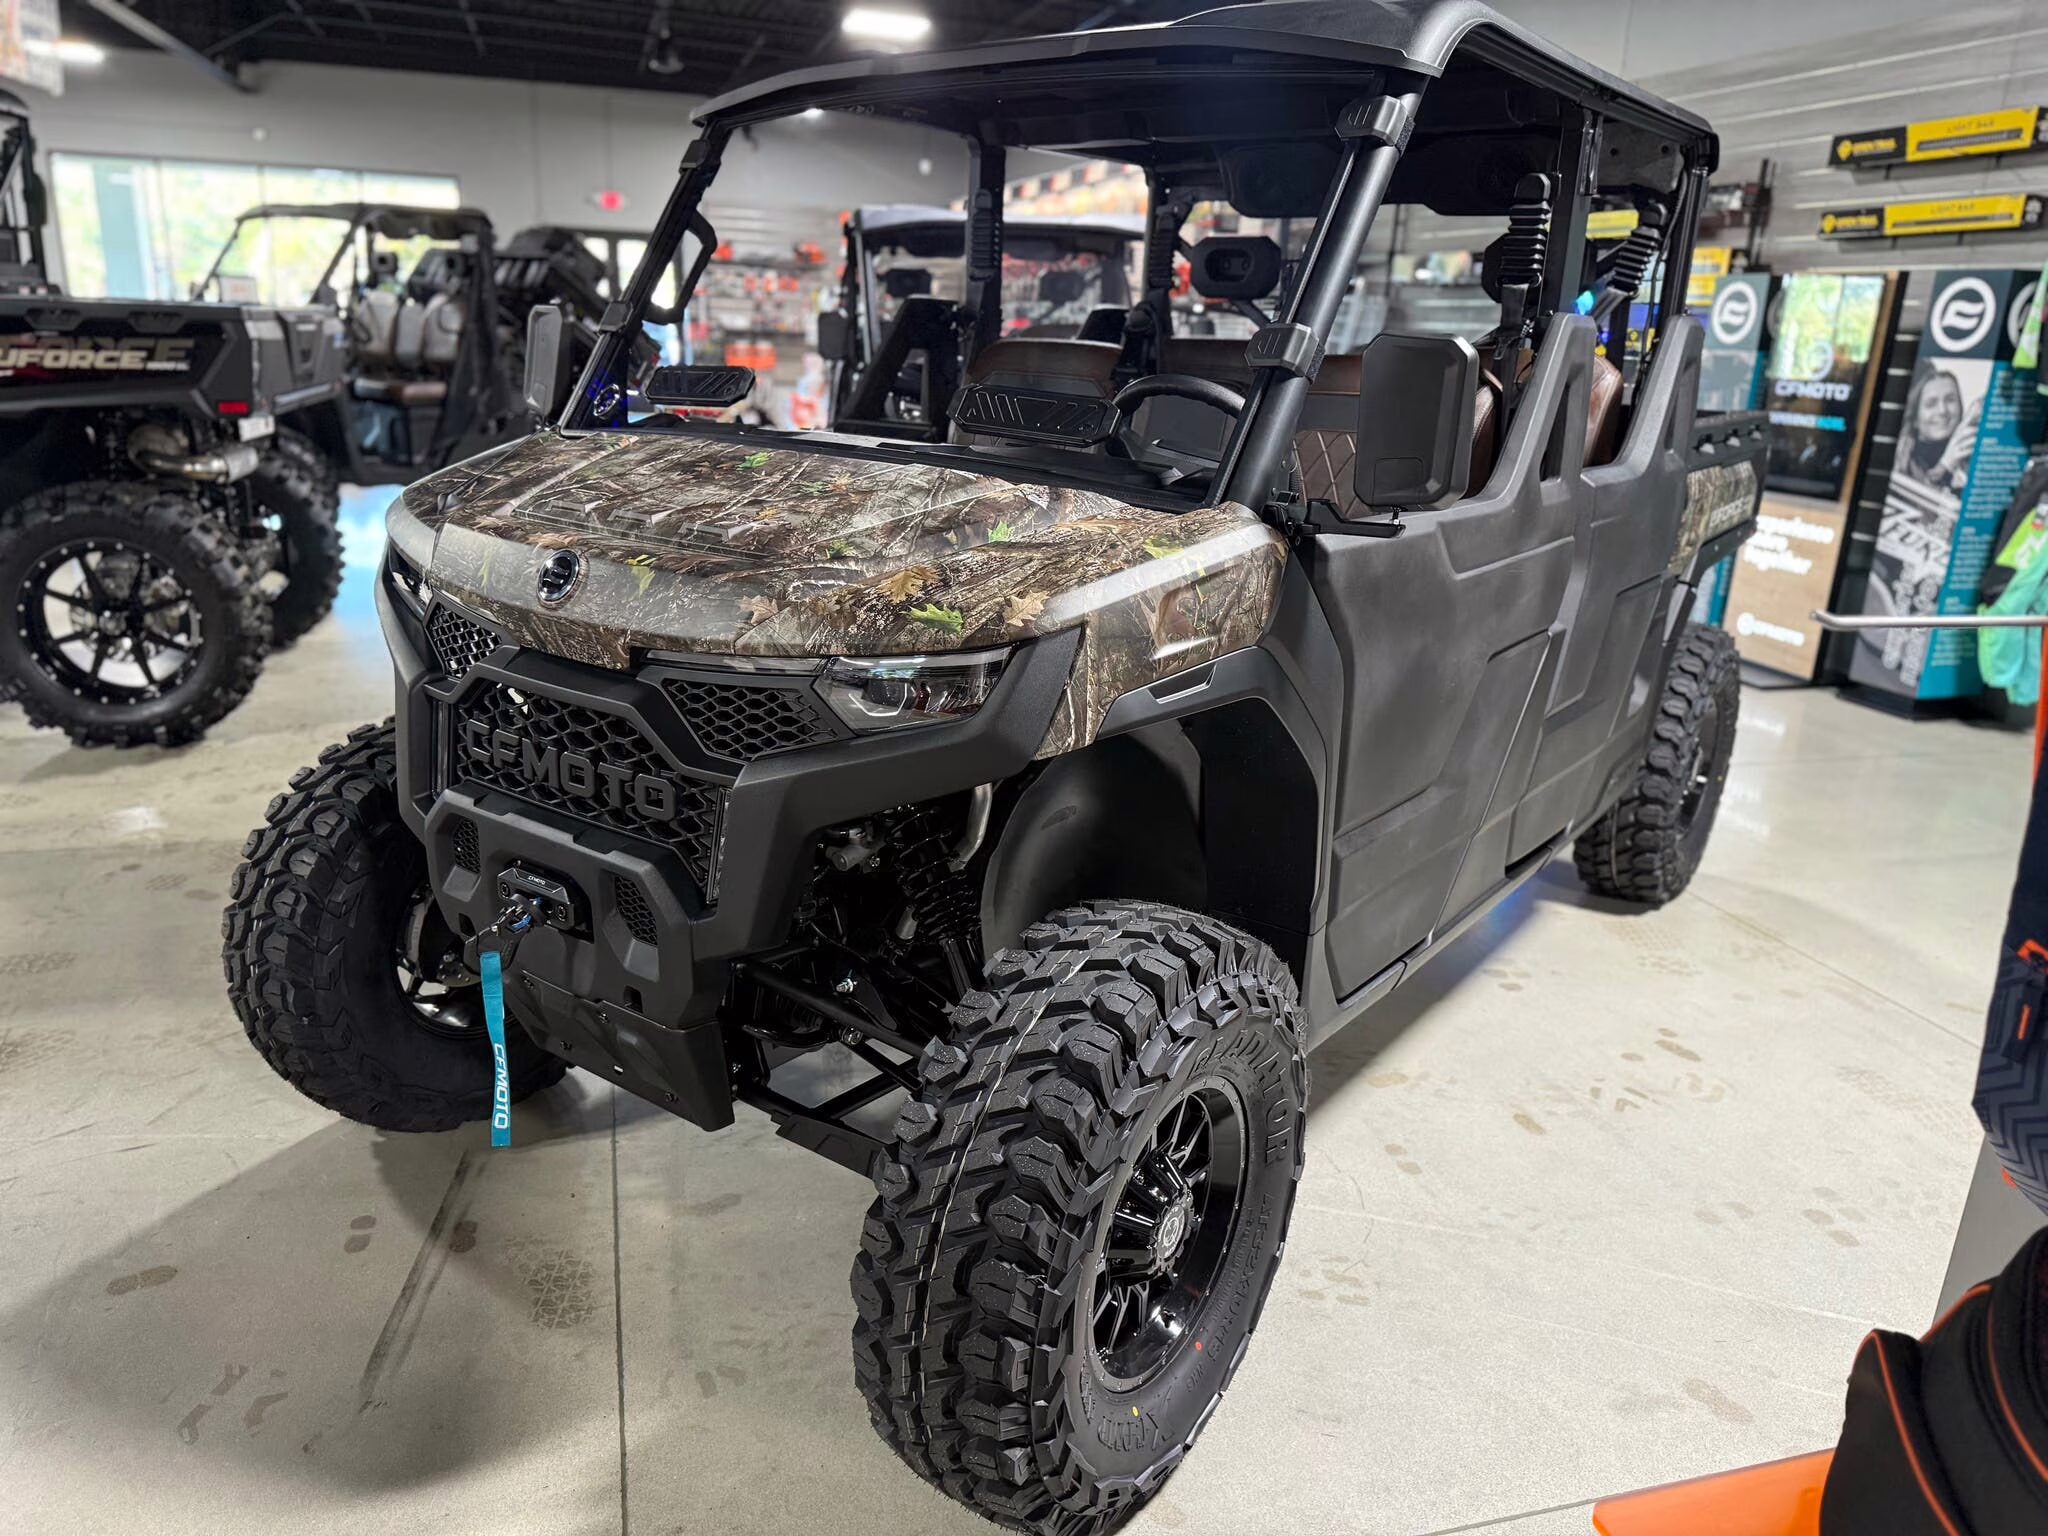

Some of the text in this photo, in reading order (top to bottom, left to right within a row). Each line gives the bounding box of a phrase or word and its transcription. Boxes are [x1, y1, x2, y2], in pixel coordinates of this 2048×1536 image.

[466, 718, 677, 822] CFMOTO
[527, 875, 546, 885] CFMOTO
[494, 1042, 509, 1129] CFMOTO
[1186, 1030, 1292, 1167] GLADIATOR
